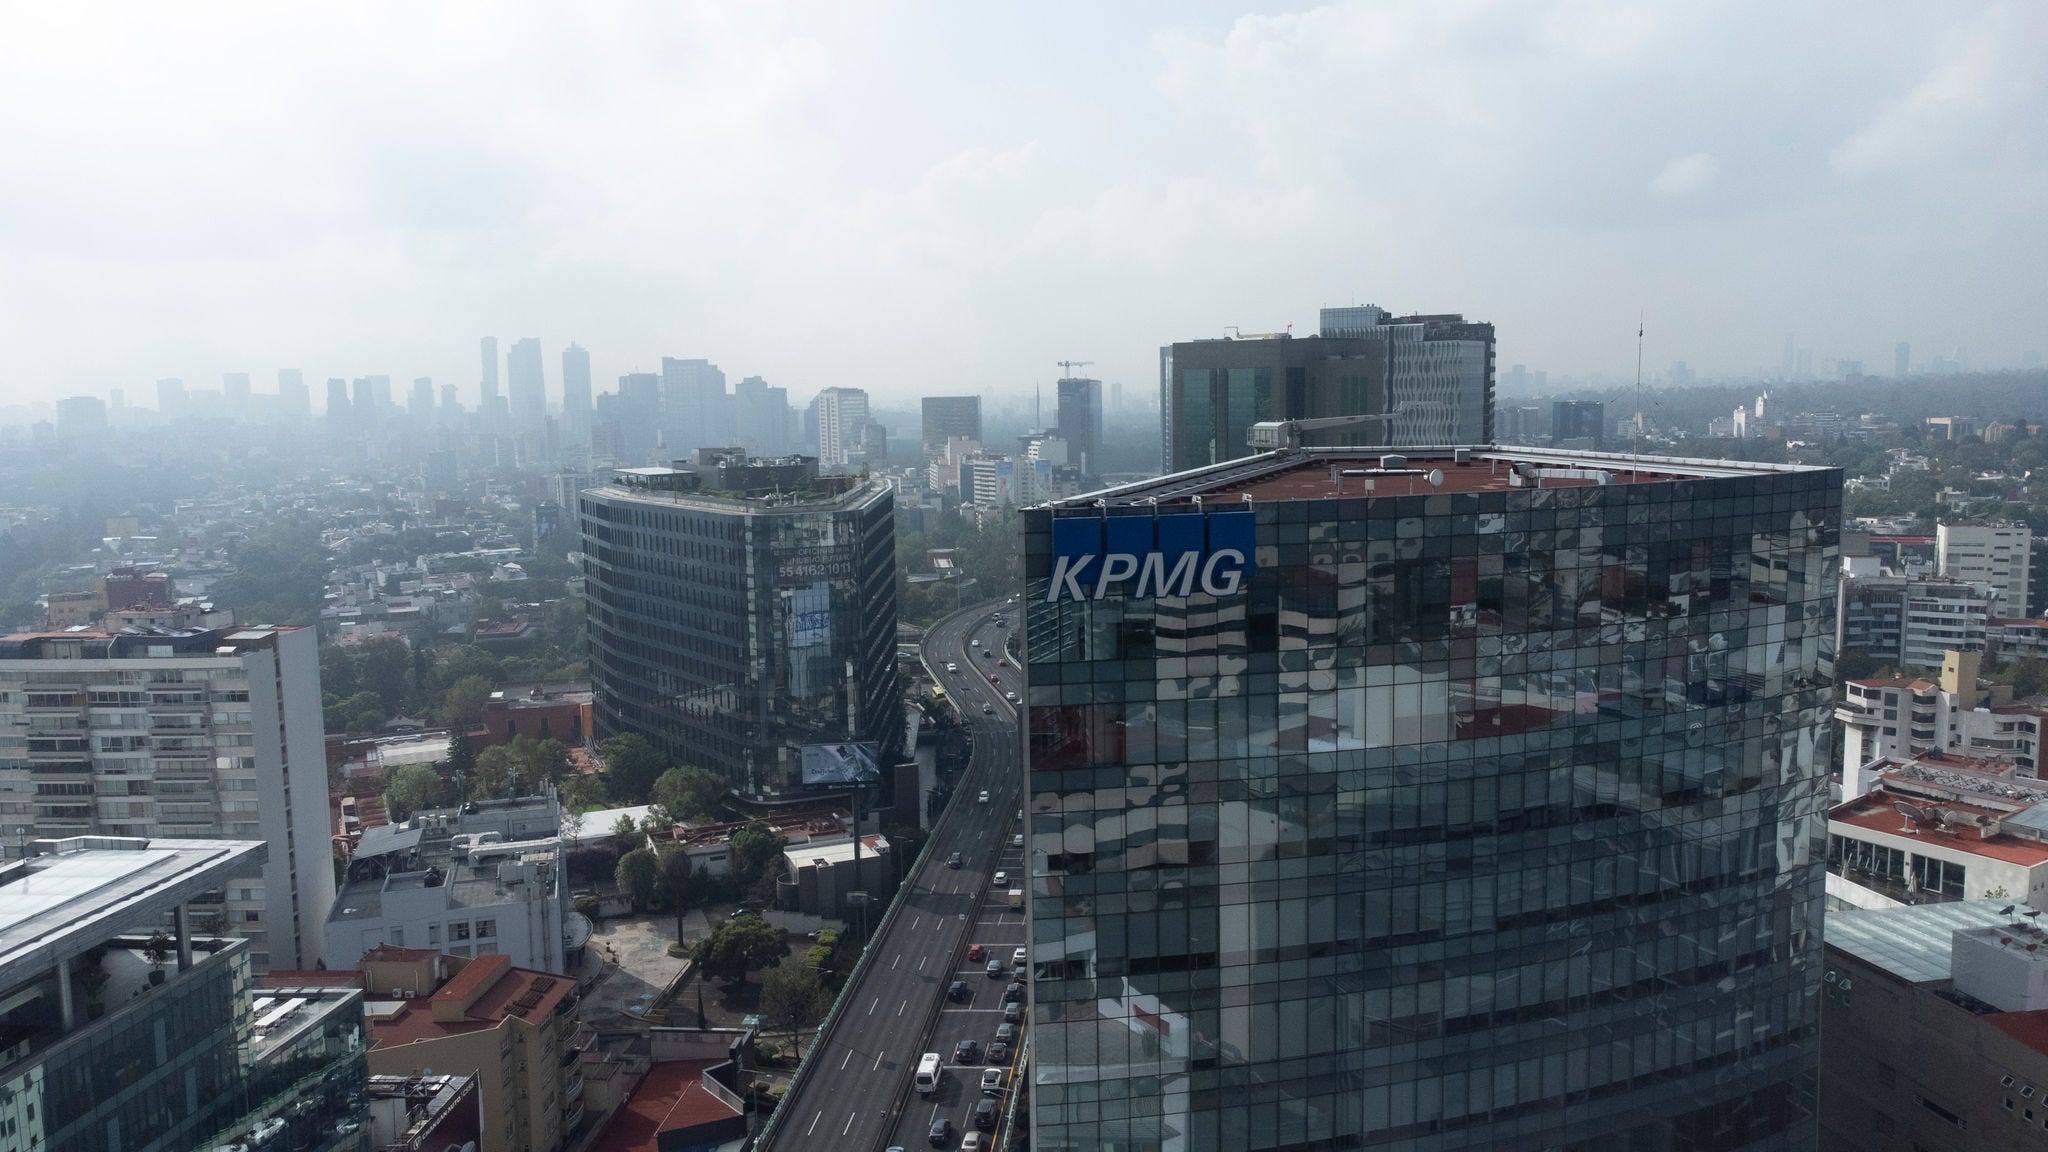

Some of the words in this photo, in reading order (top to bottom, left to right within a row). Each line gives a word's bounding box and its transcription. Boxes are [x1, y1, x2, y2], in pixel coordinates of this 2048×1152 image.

[779, 566, 794, 577] 55
[795, 564, 825, 577] 4162
[1046, 548, 1245, 603] KPMG
